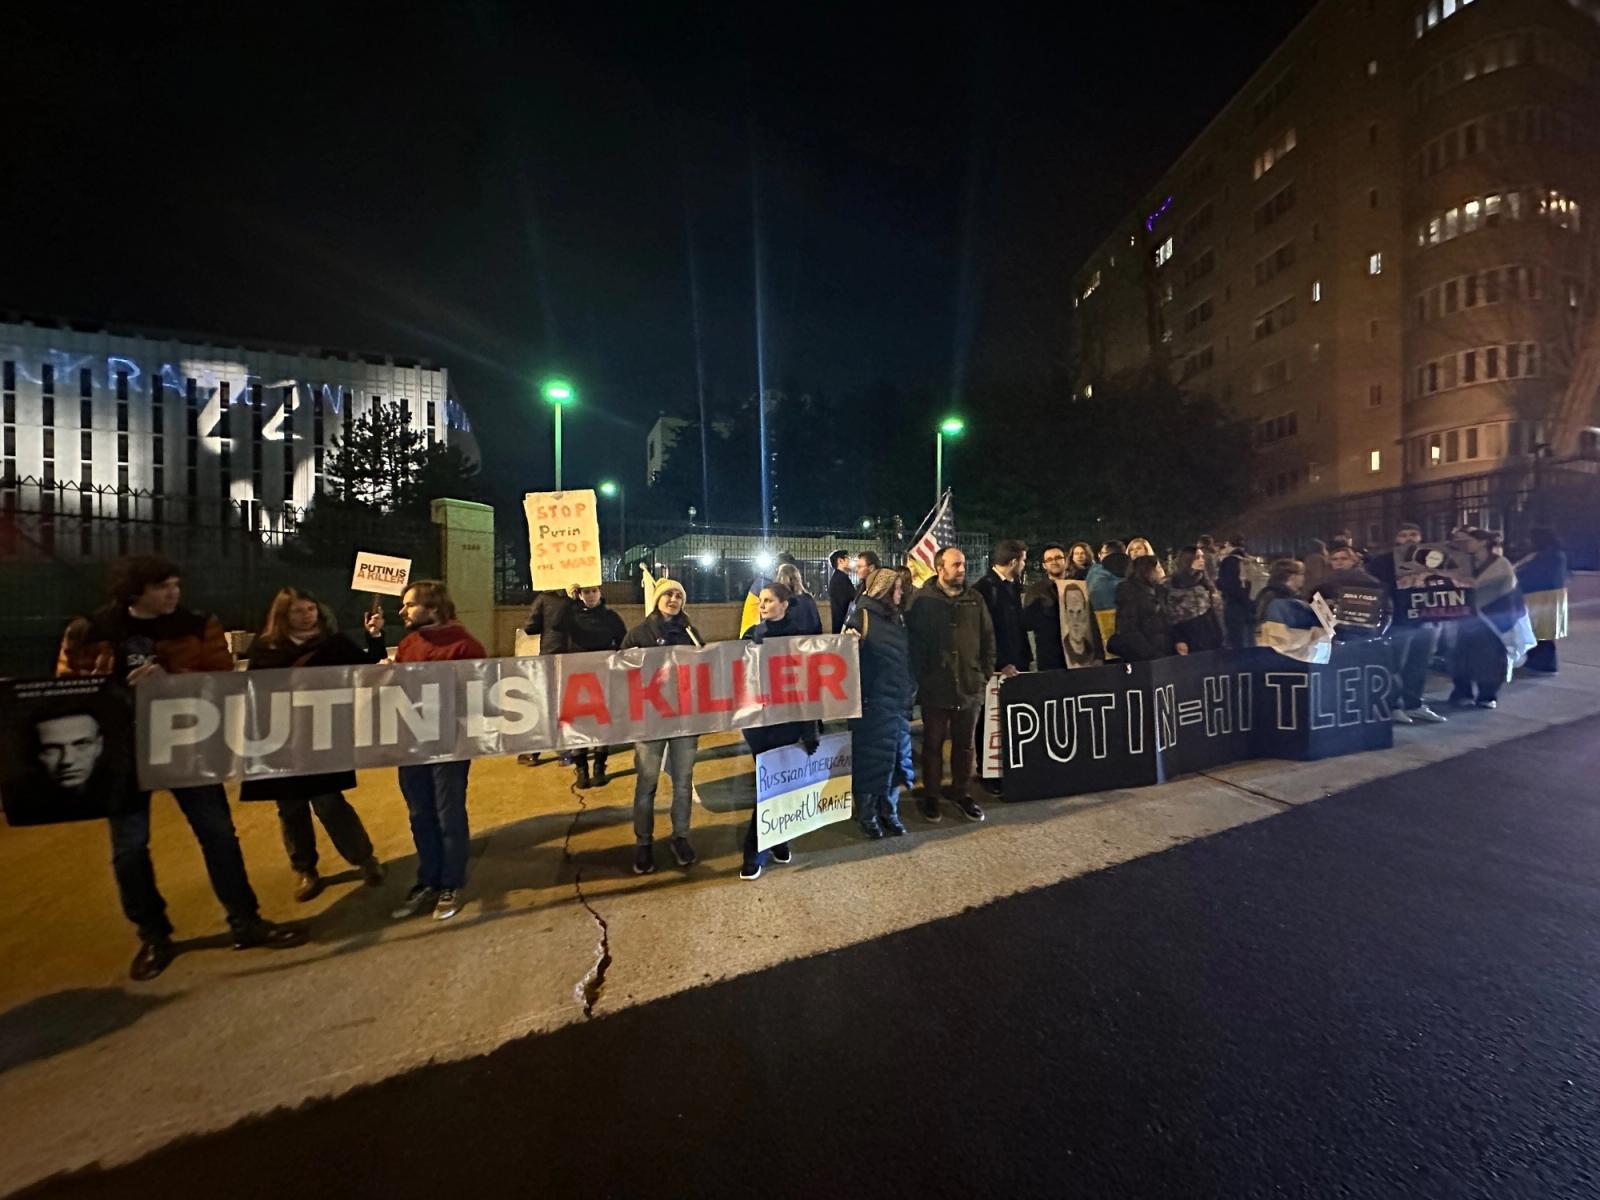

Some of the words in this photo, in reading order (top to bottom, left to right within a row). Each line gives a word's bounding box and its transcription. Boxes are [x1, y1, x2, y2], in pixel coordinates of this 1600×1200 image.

[537, 503, 586, 519] STOP
[536, 541, 592, 557] STOP
[360, 563, 394, 575] PUTIN
[396, 568, 407, 577] IS
[367, 573, 404, 584] KILLER
[1411, 589, 1466, 609] PUTIN
[149, 682, 441, 765] PUTIN
[466, 675, 540, 737] IS
[557, 672, 613, 728] A
[626, 652, 850, 722] KILLER
